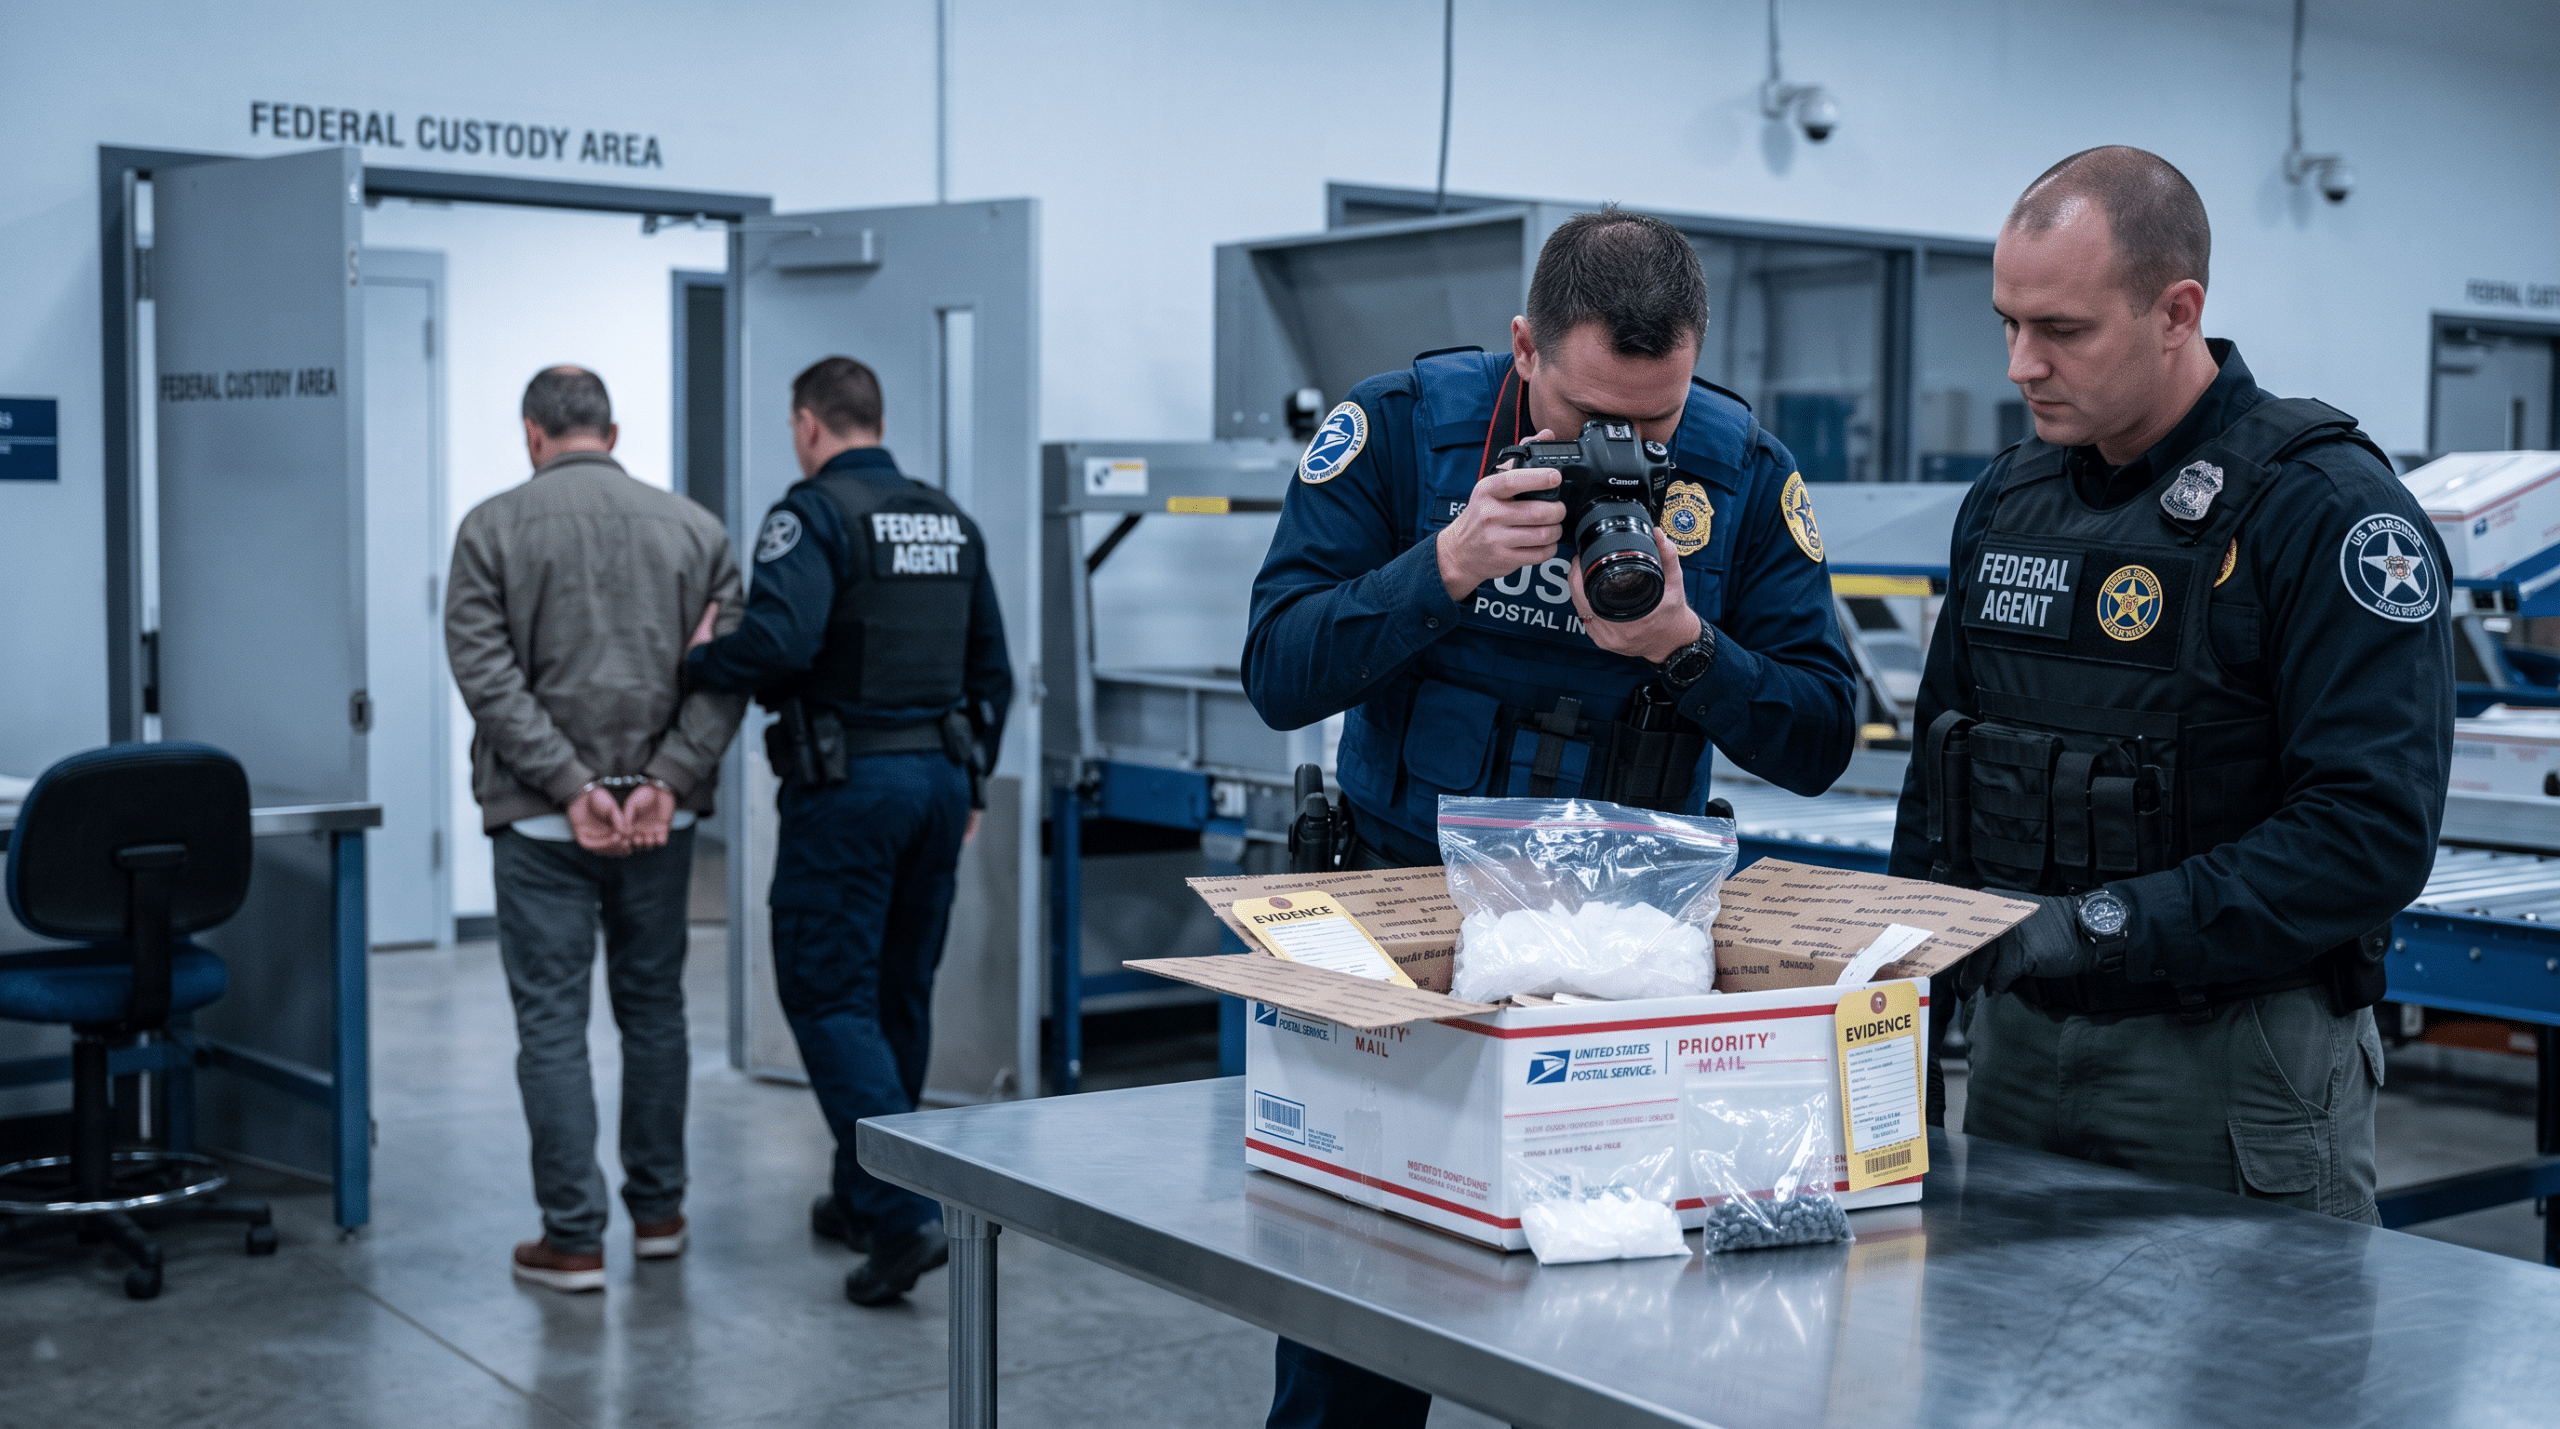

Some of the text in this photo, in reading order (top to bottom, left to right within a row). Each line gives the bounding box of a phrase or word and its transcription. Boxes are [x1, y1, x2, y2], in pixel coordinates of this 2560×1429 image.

[250, 100, 663, 169] FEDERAL CUSTODY AREA
[159, 366, 337, 402] FEDERAL CUSTODY AREA
[1608, 477, 1639, 486] Canon
[871, 513, 967, 545] FEDERAL
[2350, 529, 2368, 547] US
[892, 544, 960, 575] AGENT
[1978, 552, 2070, 593] FEDERAL
[1493, 557, 1573, 605] US
[1474, 596, 1560, 631] POSTAL
[1980, 589, 2054, 628] AGENT
[1253, 905, 1334, 925] EVIDENCE
[1845, 1013, 1912, 1043] EVIDENCE
[1355, 1036, 1389, 1059] MAIL
[1575, 1043, 1651, 1060] UNITED STATES
[1571, 1067, 1609, 1081] POSTAL
[1699, 1056, 1746, 1074] MAIL
